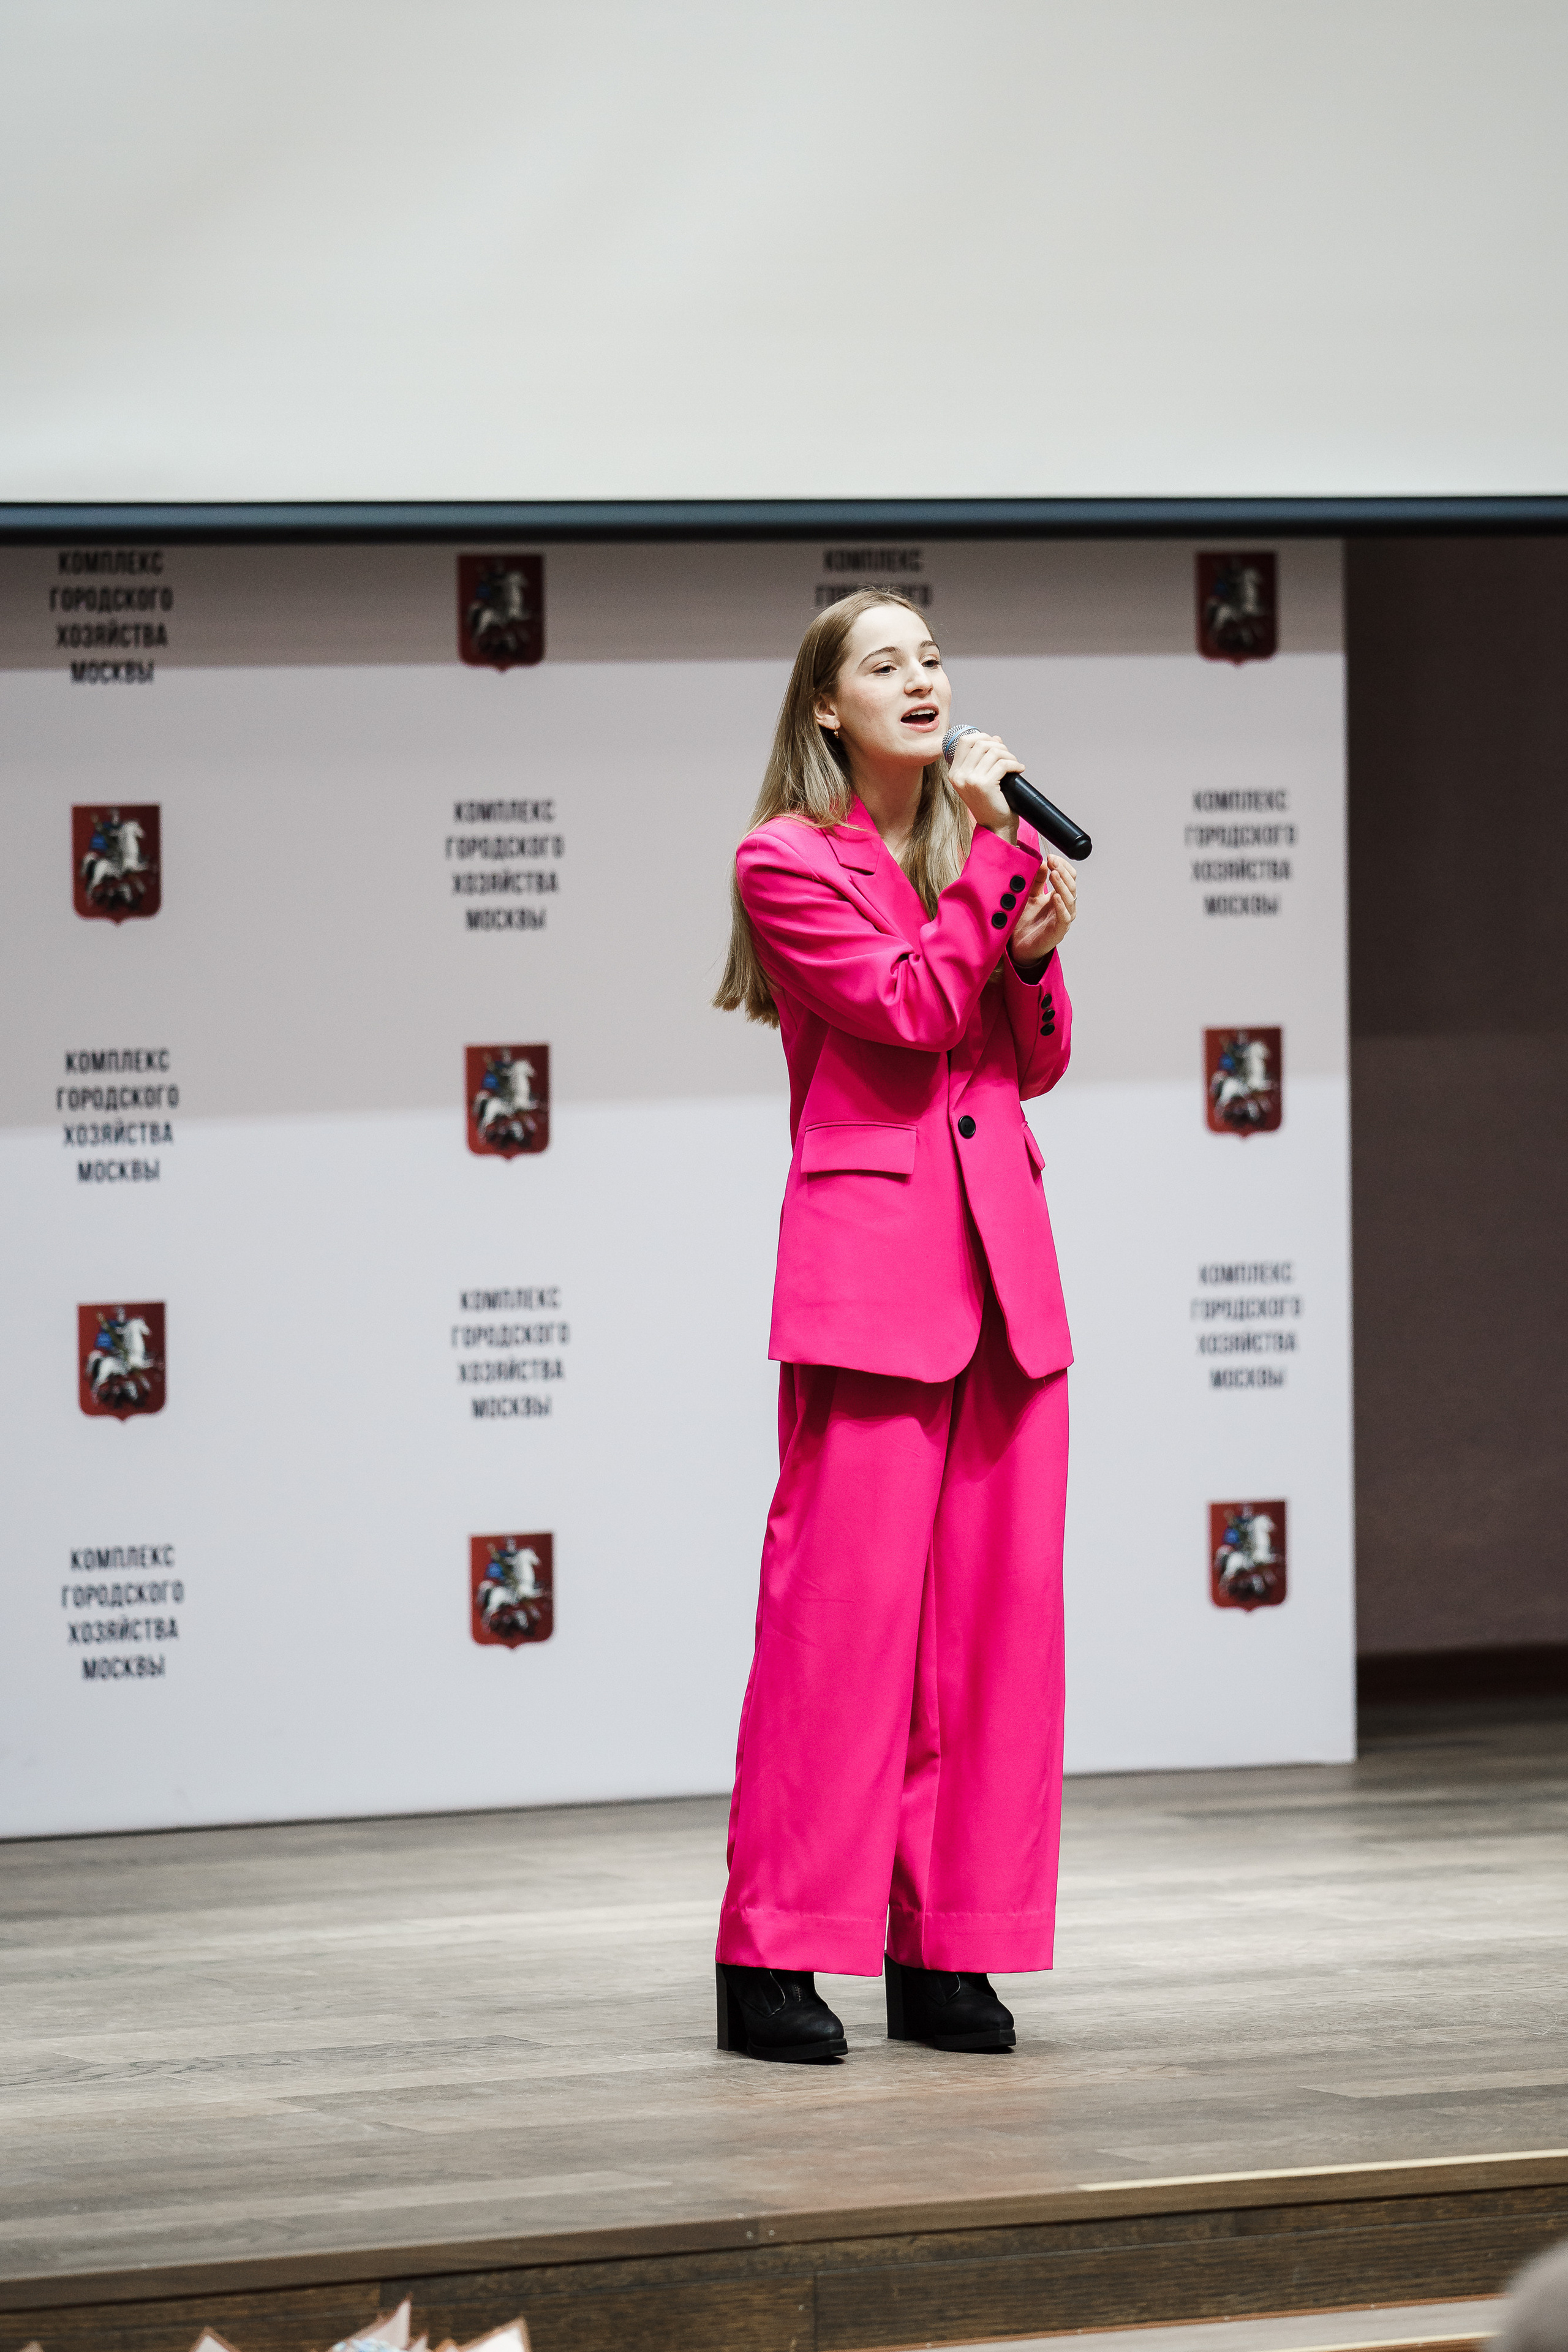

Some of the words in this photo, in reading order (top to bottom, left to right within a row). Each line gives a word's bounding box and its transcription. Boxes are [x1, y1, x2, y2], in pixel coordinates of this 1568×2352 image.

[56, 549, 165, 575] КОМПЛЕКС
[49, 587, 173, 612] ГОРОДСКОГО
[55, 620, 169, 648] ХОЗЯЙСТВА
[68, 660, 156, 685] МОСКВЫ
[453, 799, 555, 823] КОМПЛЕКС
[1192, 790, 1287, 812] КОМПЛЕКС
[444, 835, 565, 861] ГОРОДСКОГО
[1185, 824, 1297, 848] ГОРОДСКОГО
[1191, 858, 1293, 881] ХОЗЯЙСТВА
[451, 870, 560, 895] ХОЗЯЙСТВА
[1202, 894, 1281, 916] МОСКВЫ
[464, 908, 547, 931] МОСКВЫ
[64, 1049, 170, 1074] КОМПЛЕКС
[55, 1085, 180, 1112] ГОРОДСКОГО
[62, 1120, 175, 1147] ХОЗЯЙСТВА
[76, 1159, 161, 1183] МОСКВЫ
[1198, 1262, 1293, 1285] КОМПЛЕКС
[458, 1287, 560, 1311] КОМПЛЕКС
[1191, 1297, 1302, 1321] ГОРОДСКОГО
[450, 1323, 570, 1348] ГОРОДСКОГО
[1197, 1332, 1298, 1355] ХОЗЯЙСТВА
[458, 1359, 565, 1383] ХОЗЯЙСТВА
[1208, 1367, 1286, 1389] МОСКВЫ
[470, 1395, 552, 1419] МОСКВЫ
[69, 1545, 175, 1571] КОМПЛЕКС
[60, 1581, 184, 1608] ГОРОДСКОГО
[67, 1618, 179, 1645] ХОЗЯЙСТВА
[80, 1655, 166, 1680] МОСКВЫ
